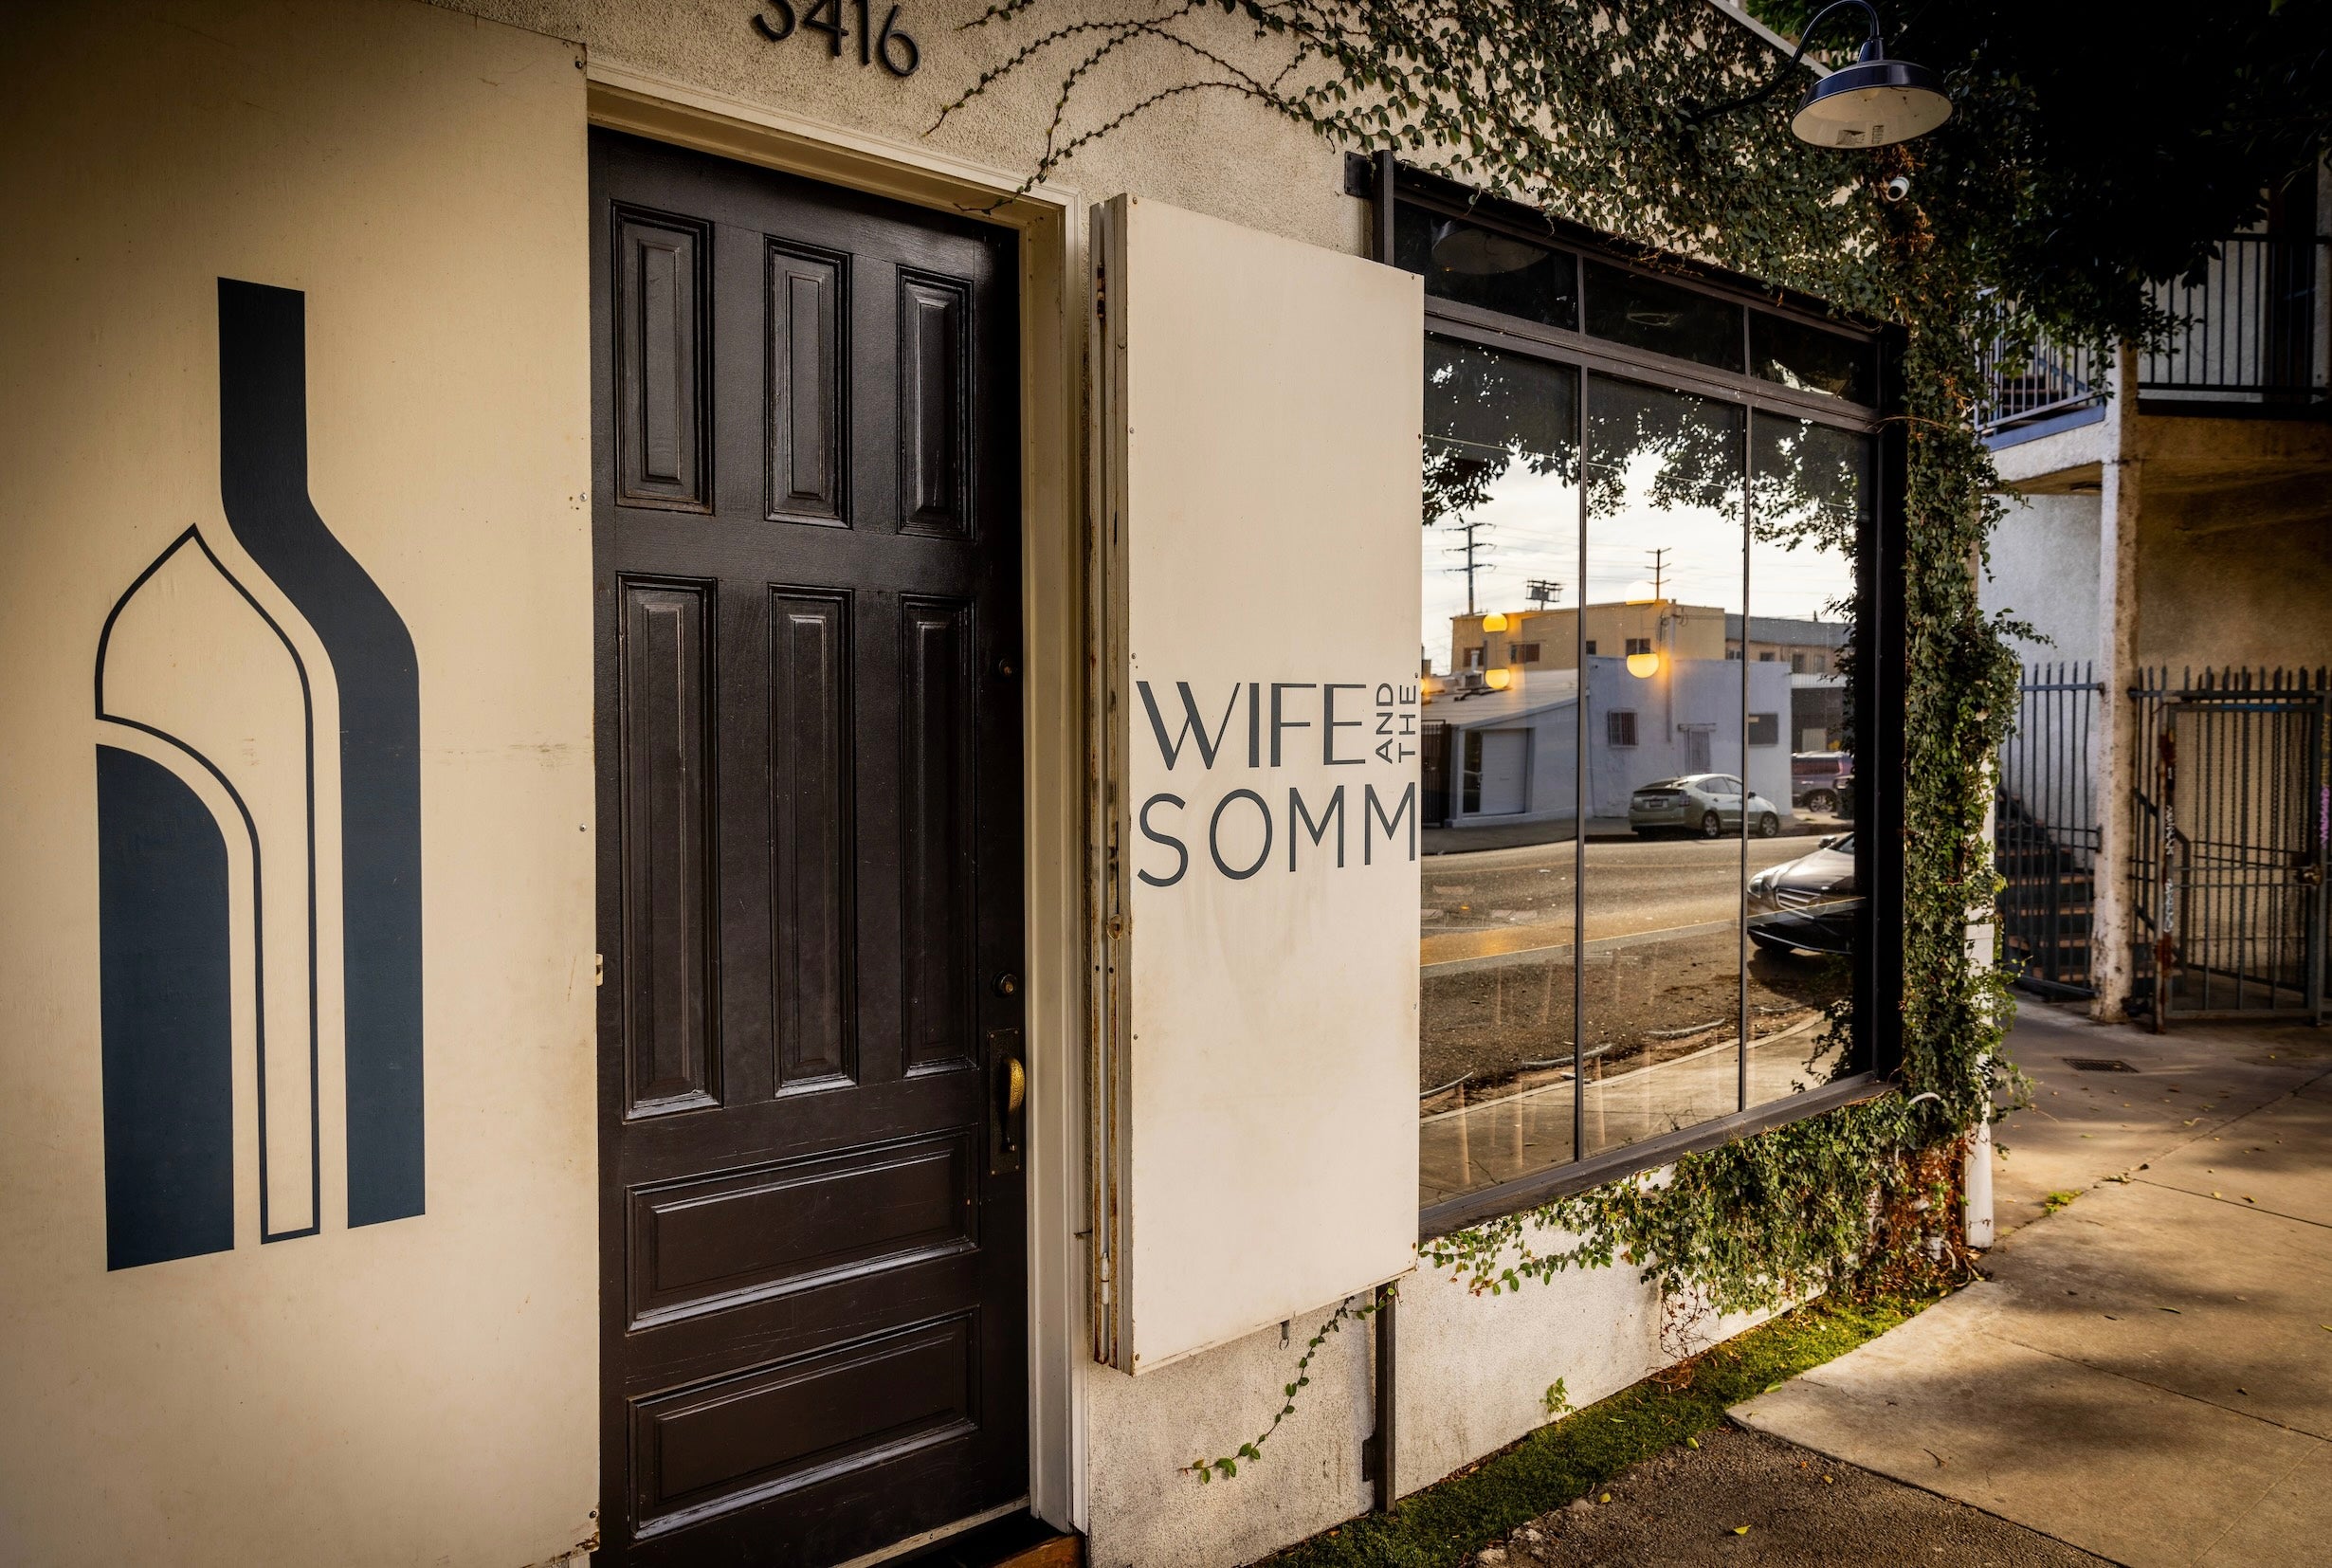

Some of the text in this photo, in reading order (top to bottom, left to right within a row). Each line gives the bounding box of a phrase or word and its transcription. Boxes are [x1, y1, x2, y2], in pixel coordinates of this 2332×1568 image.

[1136, 681, 1367, 771] WIFE
[1375, 683, 1394, 764] AND
[1398, 684, 1416, 763] THE
[1137, 782, 1415, 887] SOMM
